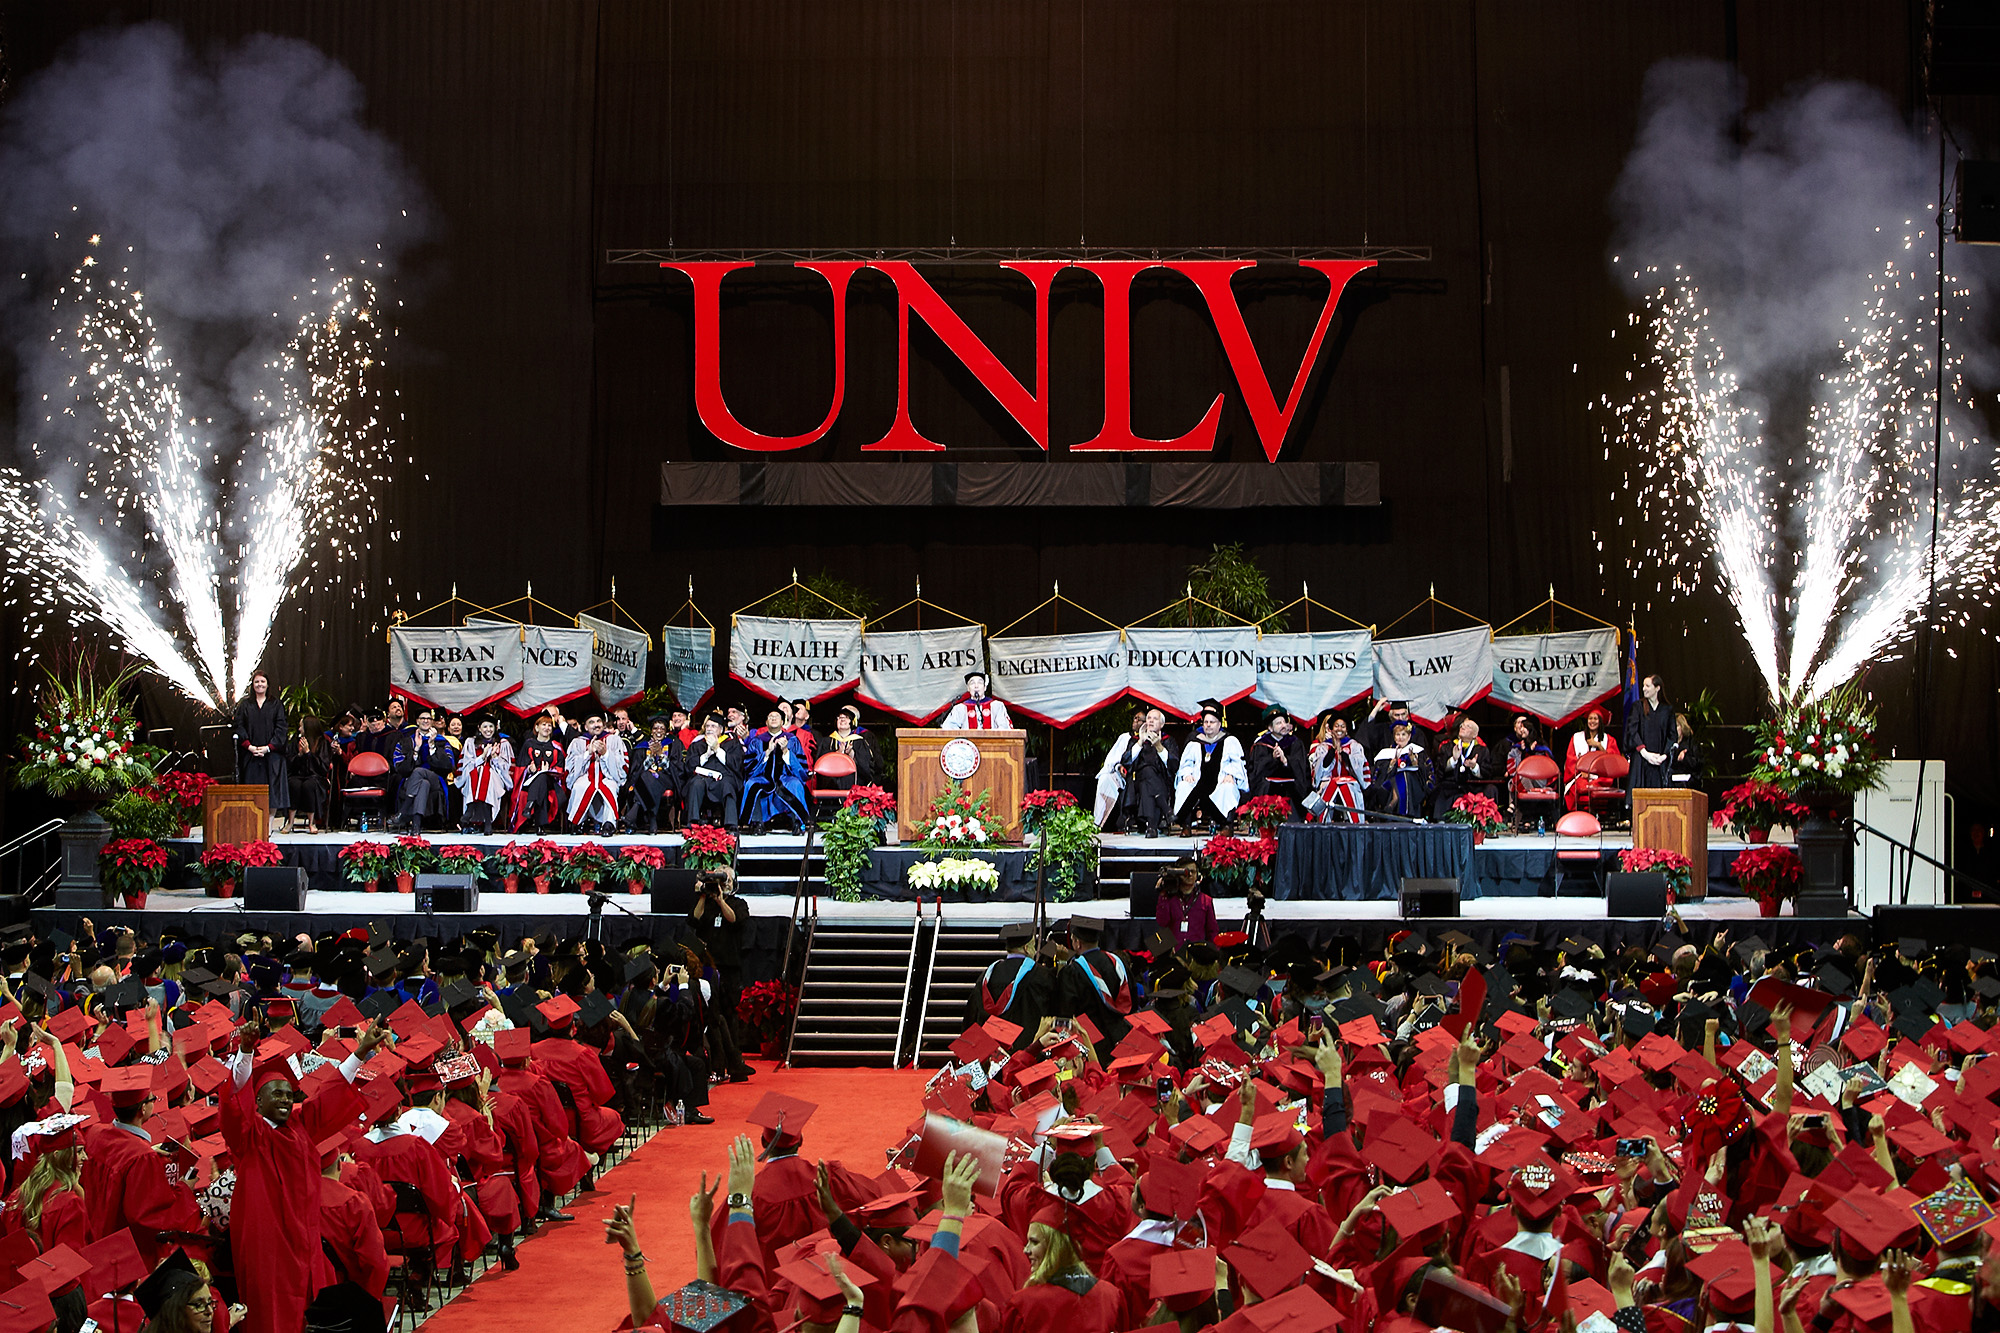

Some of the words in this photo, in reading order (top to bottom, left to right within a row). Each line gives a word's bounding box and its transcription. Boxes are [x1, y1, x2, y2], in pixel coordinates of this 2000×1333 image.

[660, 260, 1378, 463] UNLV
[411, 645, 496, 664] URBAN
[522, 646, 578, 668] NCES
[752, 638, 839, 659] HEALTH
[1127, 649, 1255, 668] EDUCATION
[745, 661, 845, 682] SCIENCES
[860, 653, 910, 673] FINE
[920, 648, 977, 671] ARTS
[997, 652, 1120, 677] ENGINEERING
[1255, 651, 1357, 674] BUSINESS
[1408, 655, 1454, 678] LAW
[1500, 650, 1603, 674] GRADUATE
[406, 665, 505, 684] AFFAIRS
[591, 663, 626, 689] ARTS
[1509, 671, 1598, 693] COLLEGE
[165, 1162, 177, 1174] 20
